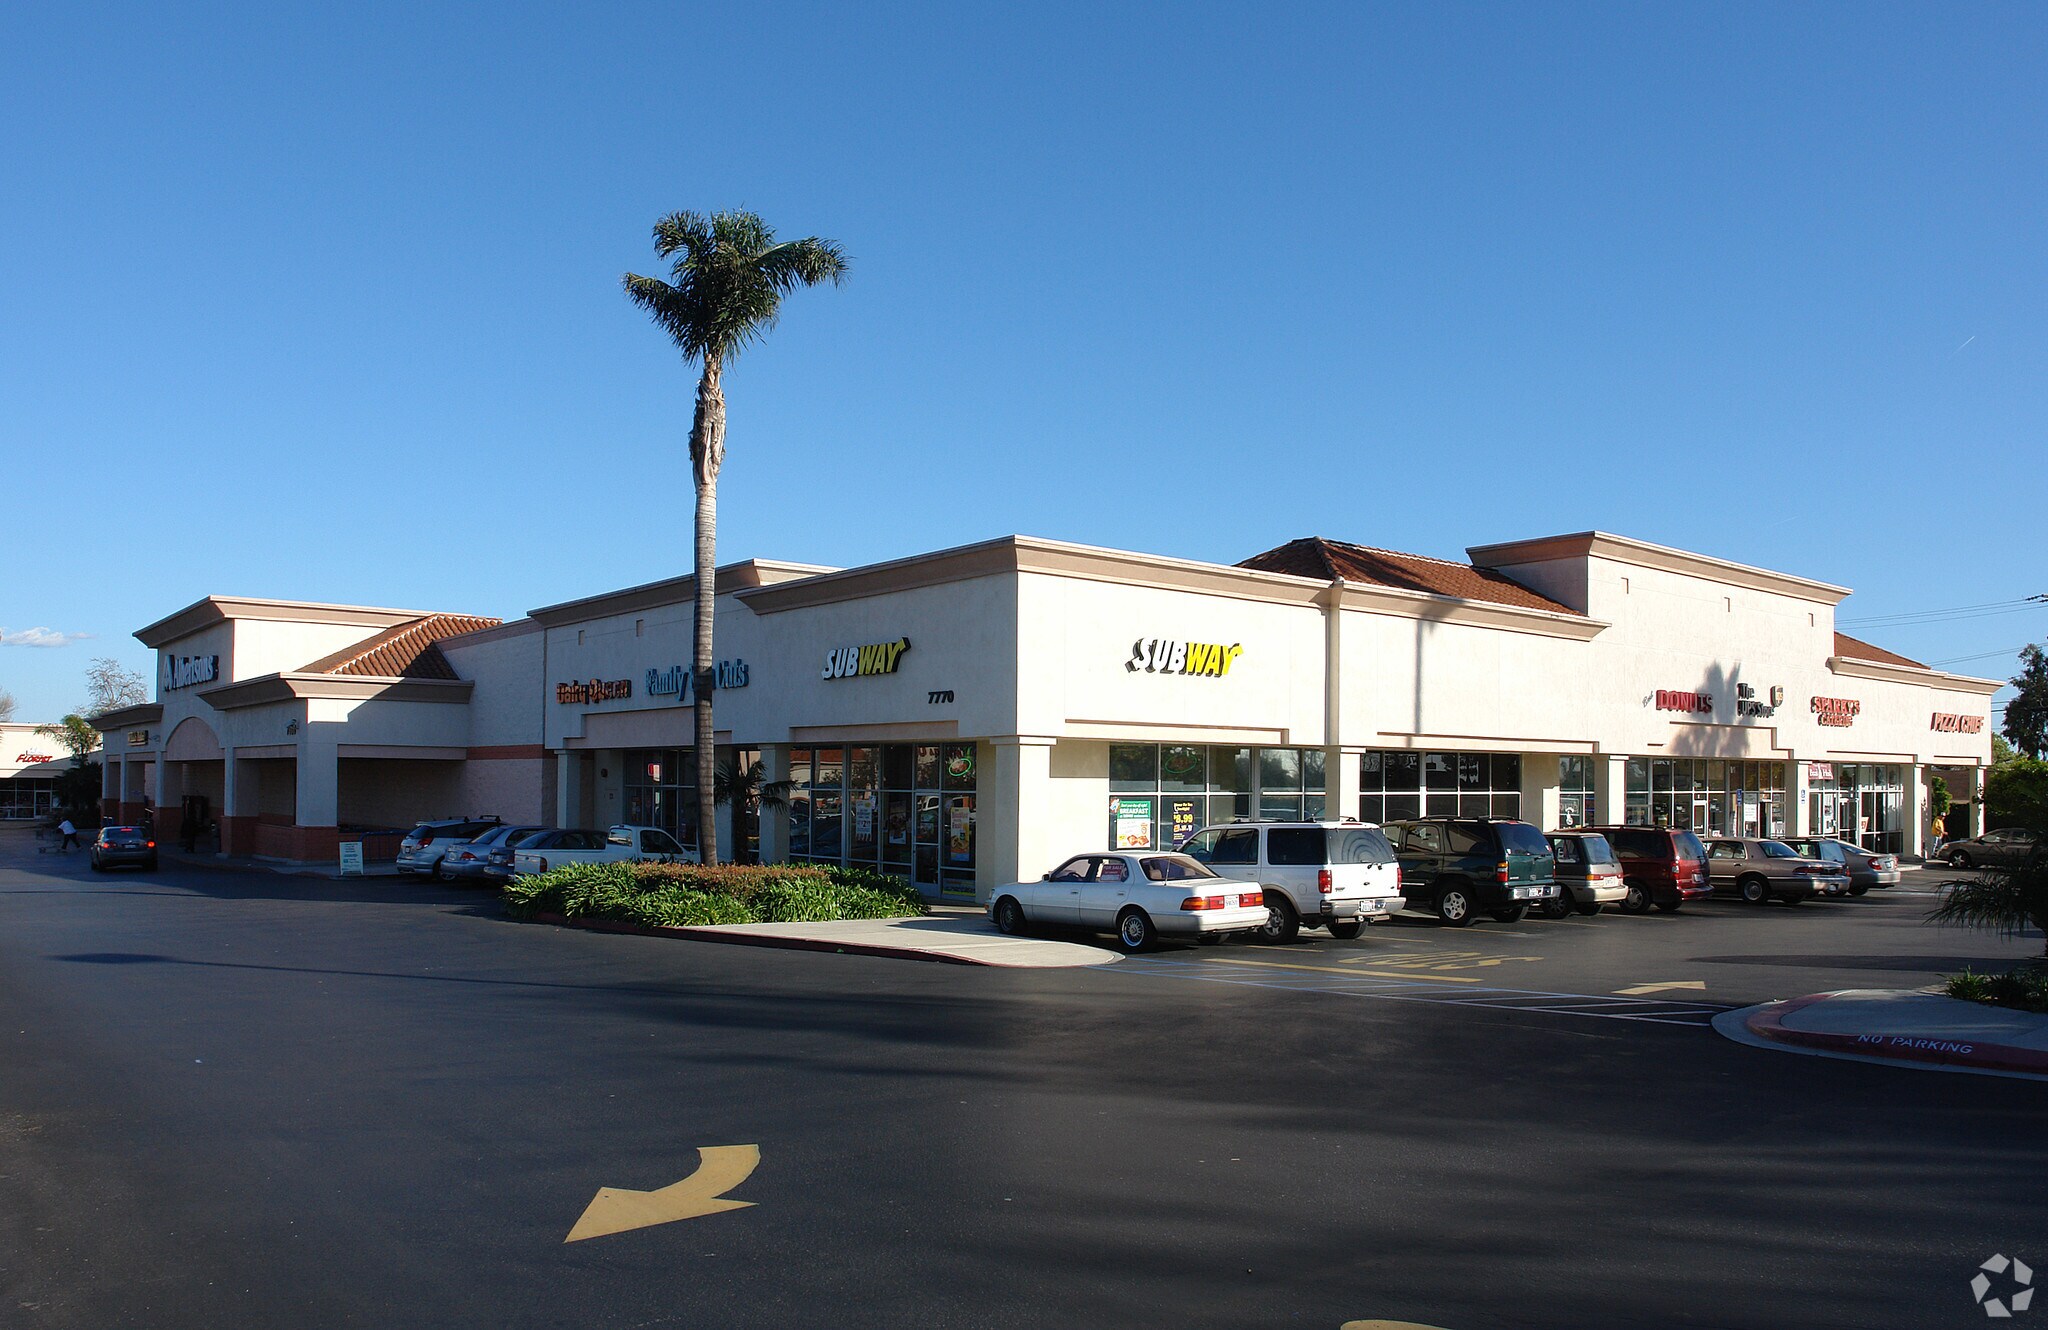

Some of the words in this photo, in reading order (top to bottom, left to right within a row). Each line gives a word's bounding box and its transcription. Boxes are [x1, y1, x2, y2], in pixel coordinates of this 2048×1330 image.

[821, 637, 911, 680] SUBWAY
[1125, 638, 1244, 678] SUBWAY
[173, 655, 219, 690] Albertsons
[645, 665, 689, 701] Family
[557, 680, 588, 705] Dairy
[589, 678, 632, 705] Queen
[928, 690, 955, 704] 7770
[1656, 689, 1713, 713] DONUTS
[1737, 683, 1755, 699] The
[1737, 700, 1756, 717] UPS
[1930, 712, 1962, 733] PIZZA
[1961, 714, 1985, 734] CHIEF
[1858, 1034, 1883, 1044] NO
[1890, 1036, 1975, 1054] PARKING
